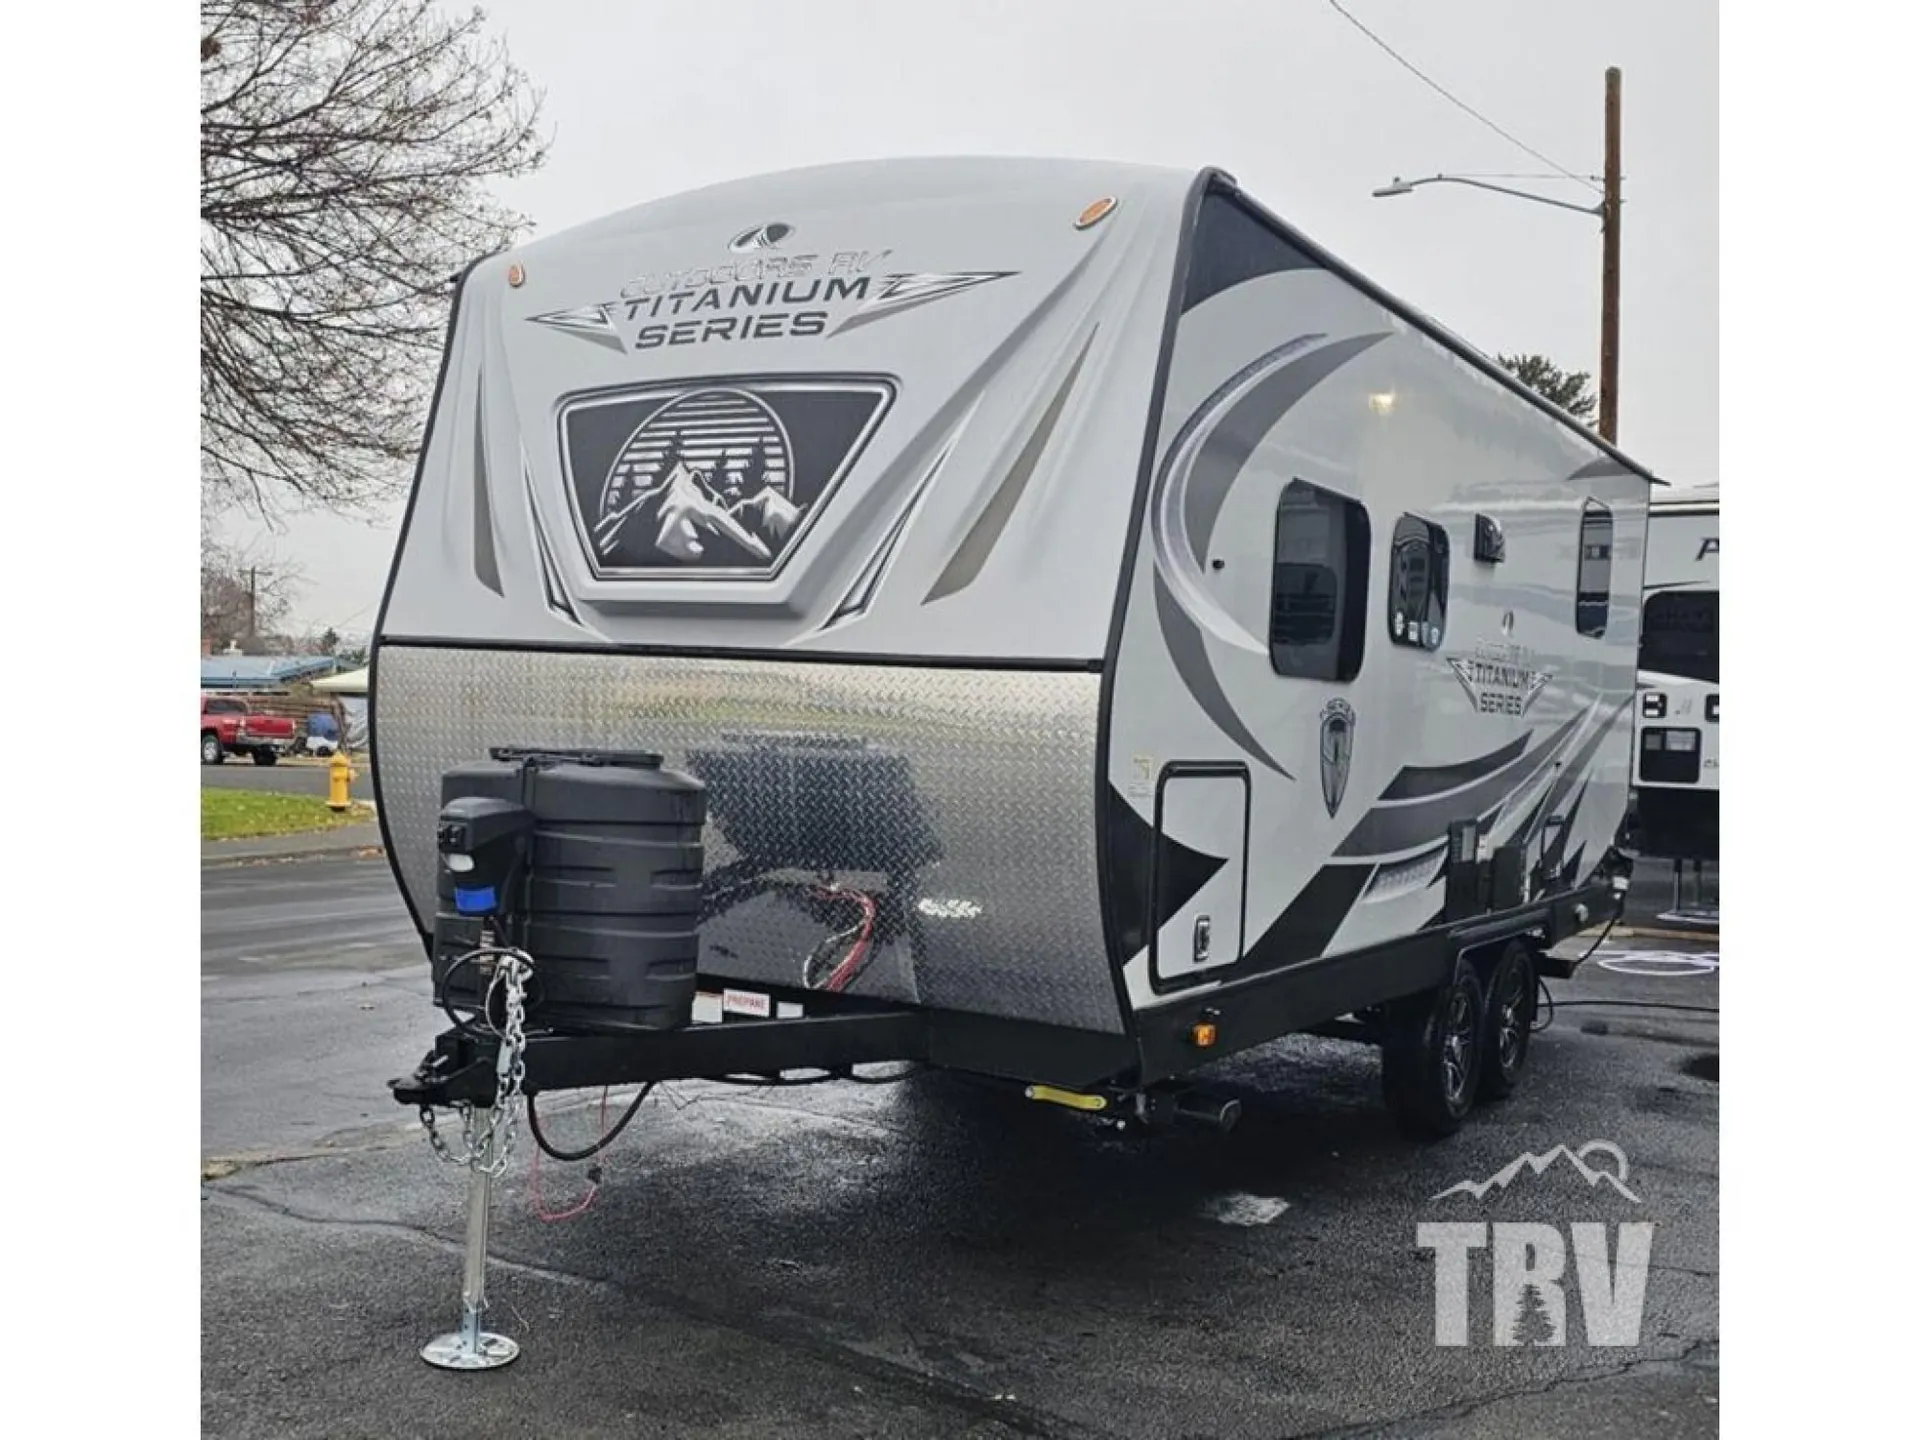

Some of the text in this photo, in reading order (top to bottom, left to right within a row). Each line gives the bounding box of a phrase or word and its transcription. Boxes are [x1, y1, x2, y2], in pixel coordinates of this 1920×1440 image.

[828, 249, 893, 275] RV
[624, 276, 872, 321] TITANIUM
[634, 310, 829, 350] SERIES
[1475, 663, 1529, 690] TITANIUM
[1481, 692, 1522, 715] SERIES
